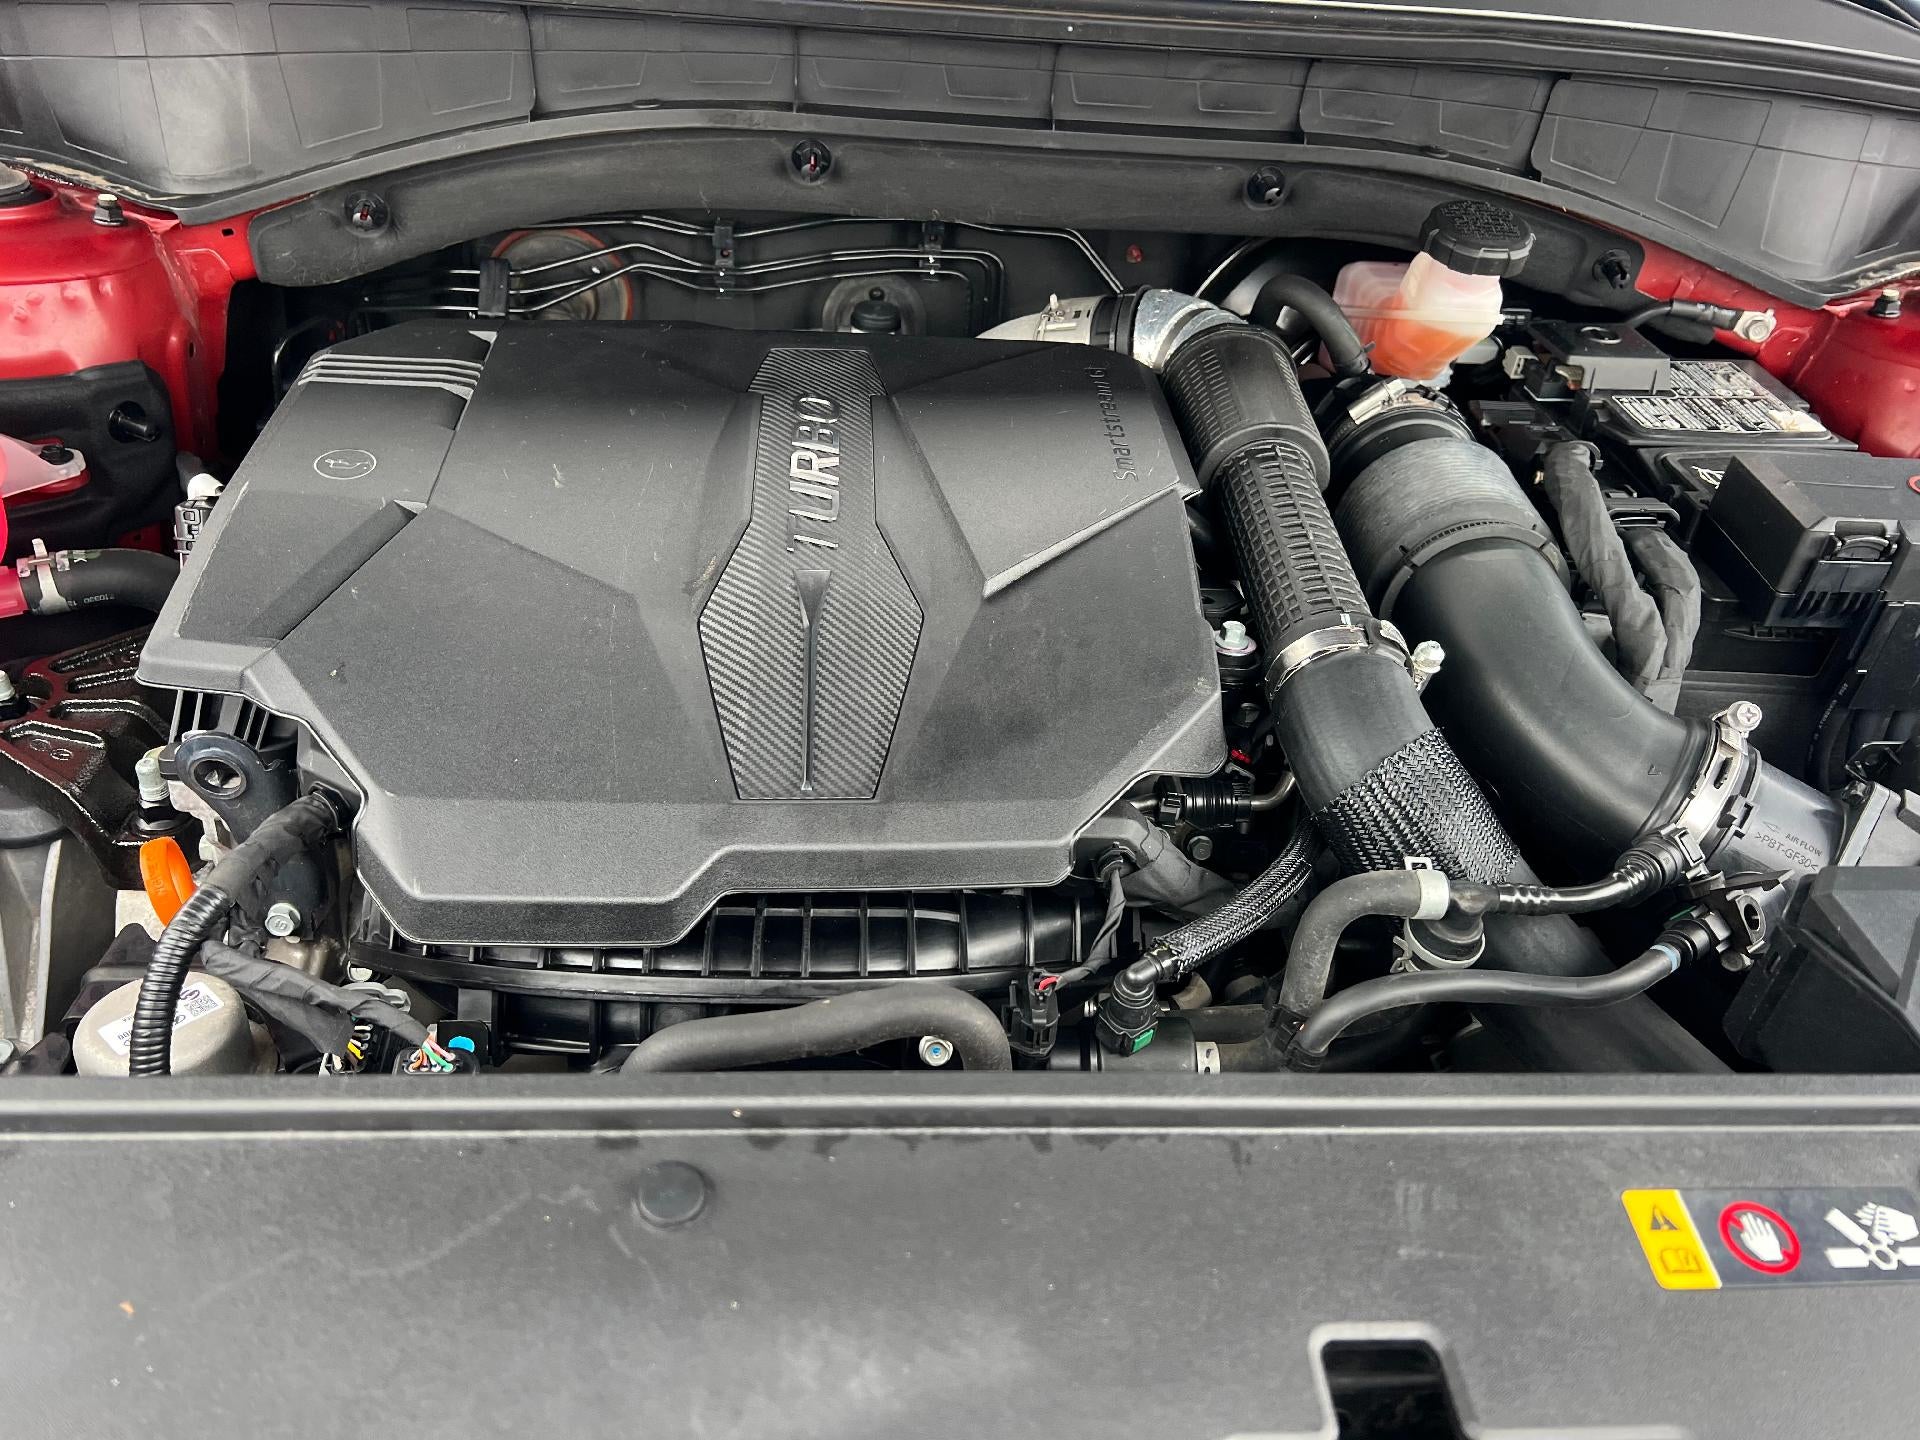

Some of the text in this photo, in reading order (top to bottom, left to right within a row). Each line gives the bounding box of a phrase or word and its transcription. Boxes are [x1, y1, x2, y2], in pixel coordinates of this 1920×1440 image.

[786, 393, 841, 552] TURBO
[1094, 380, 1138, 481] Smartstream
[1785, 832, 1823, 857] AIR FLOW
